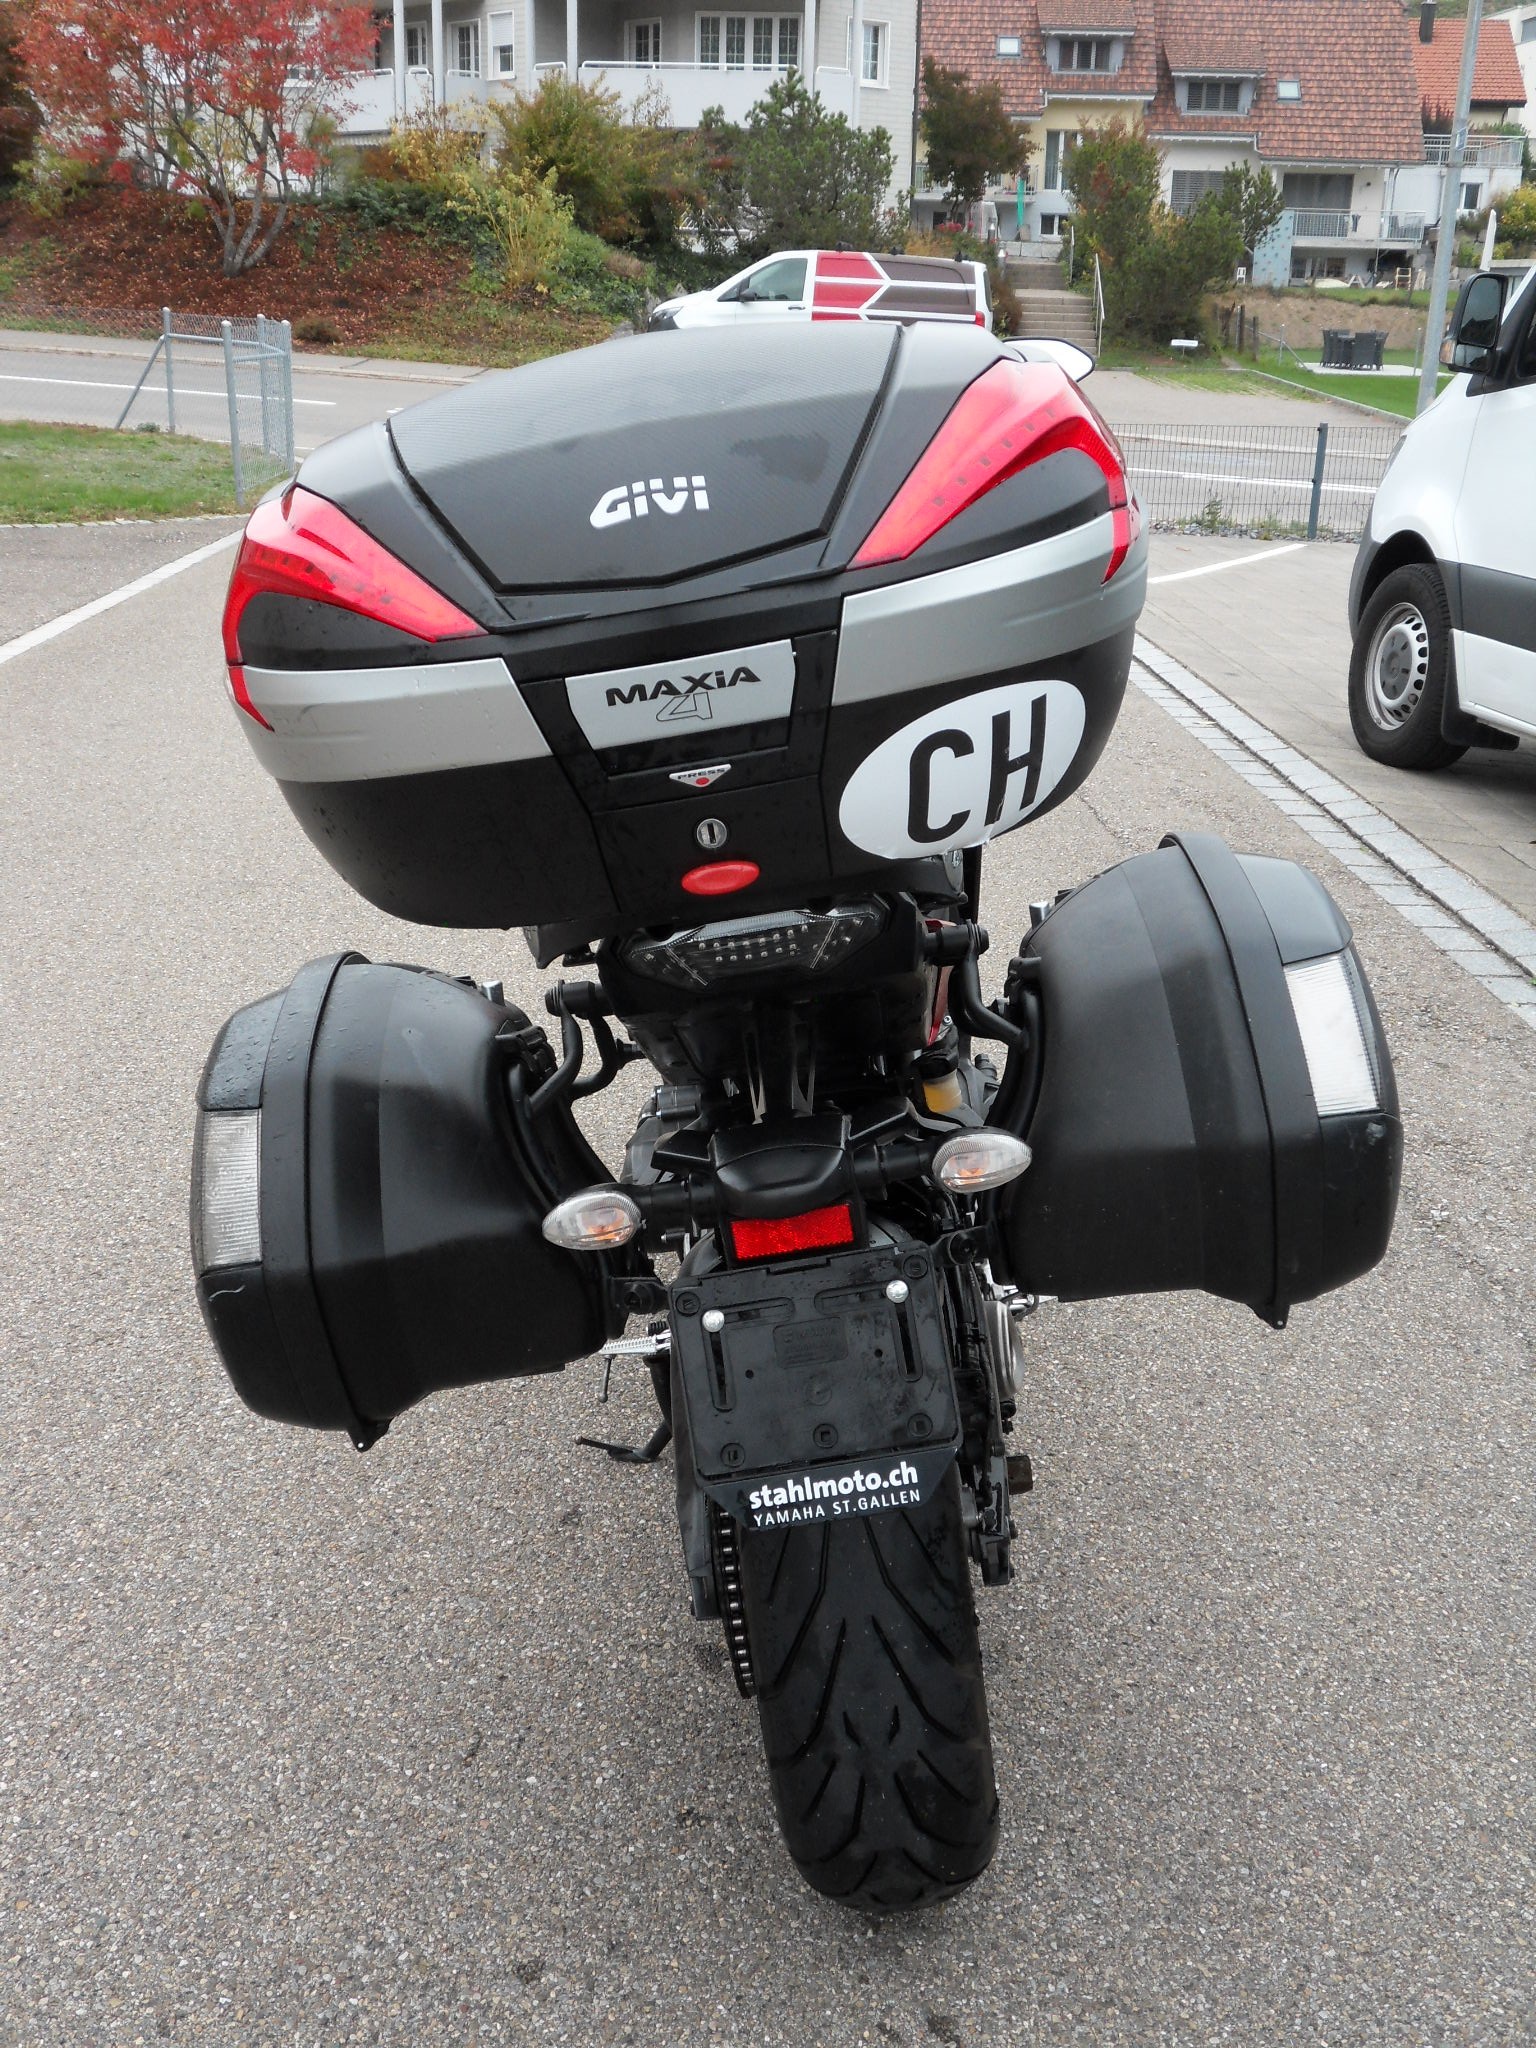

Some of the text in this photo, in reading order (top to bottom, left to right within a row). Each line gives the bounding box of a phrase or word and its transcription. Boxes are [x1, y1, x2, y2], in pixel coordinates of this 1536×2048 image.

[677, 768, 726, 780] PRESS
[907, 694, 1048, 843] CH
[749, 1460, 919, 1510] stahlmoto.ch
[753, 1488, 921, 1527] YAMAHA ST.GALLEN
